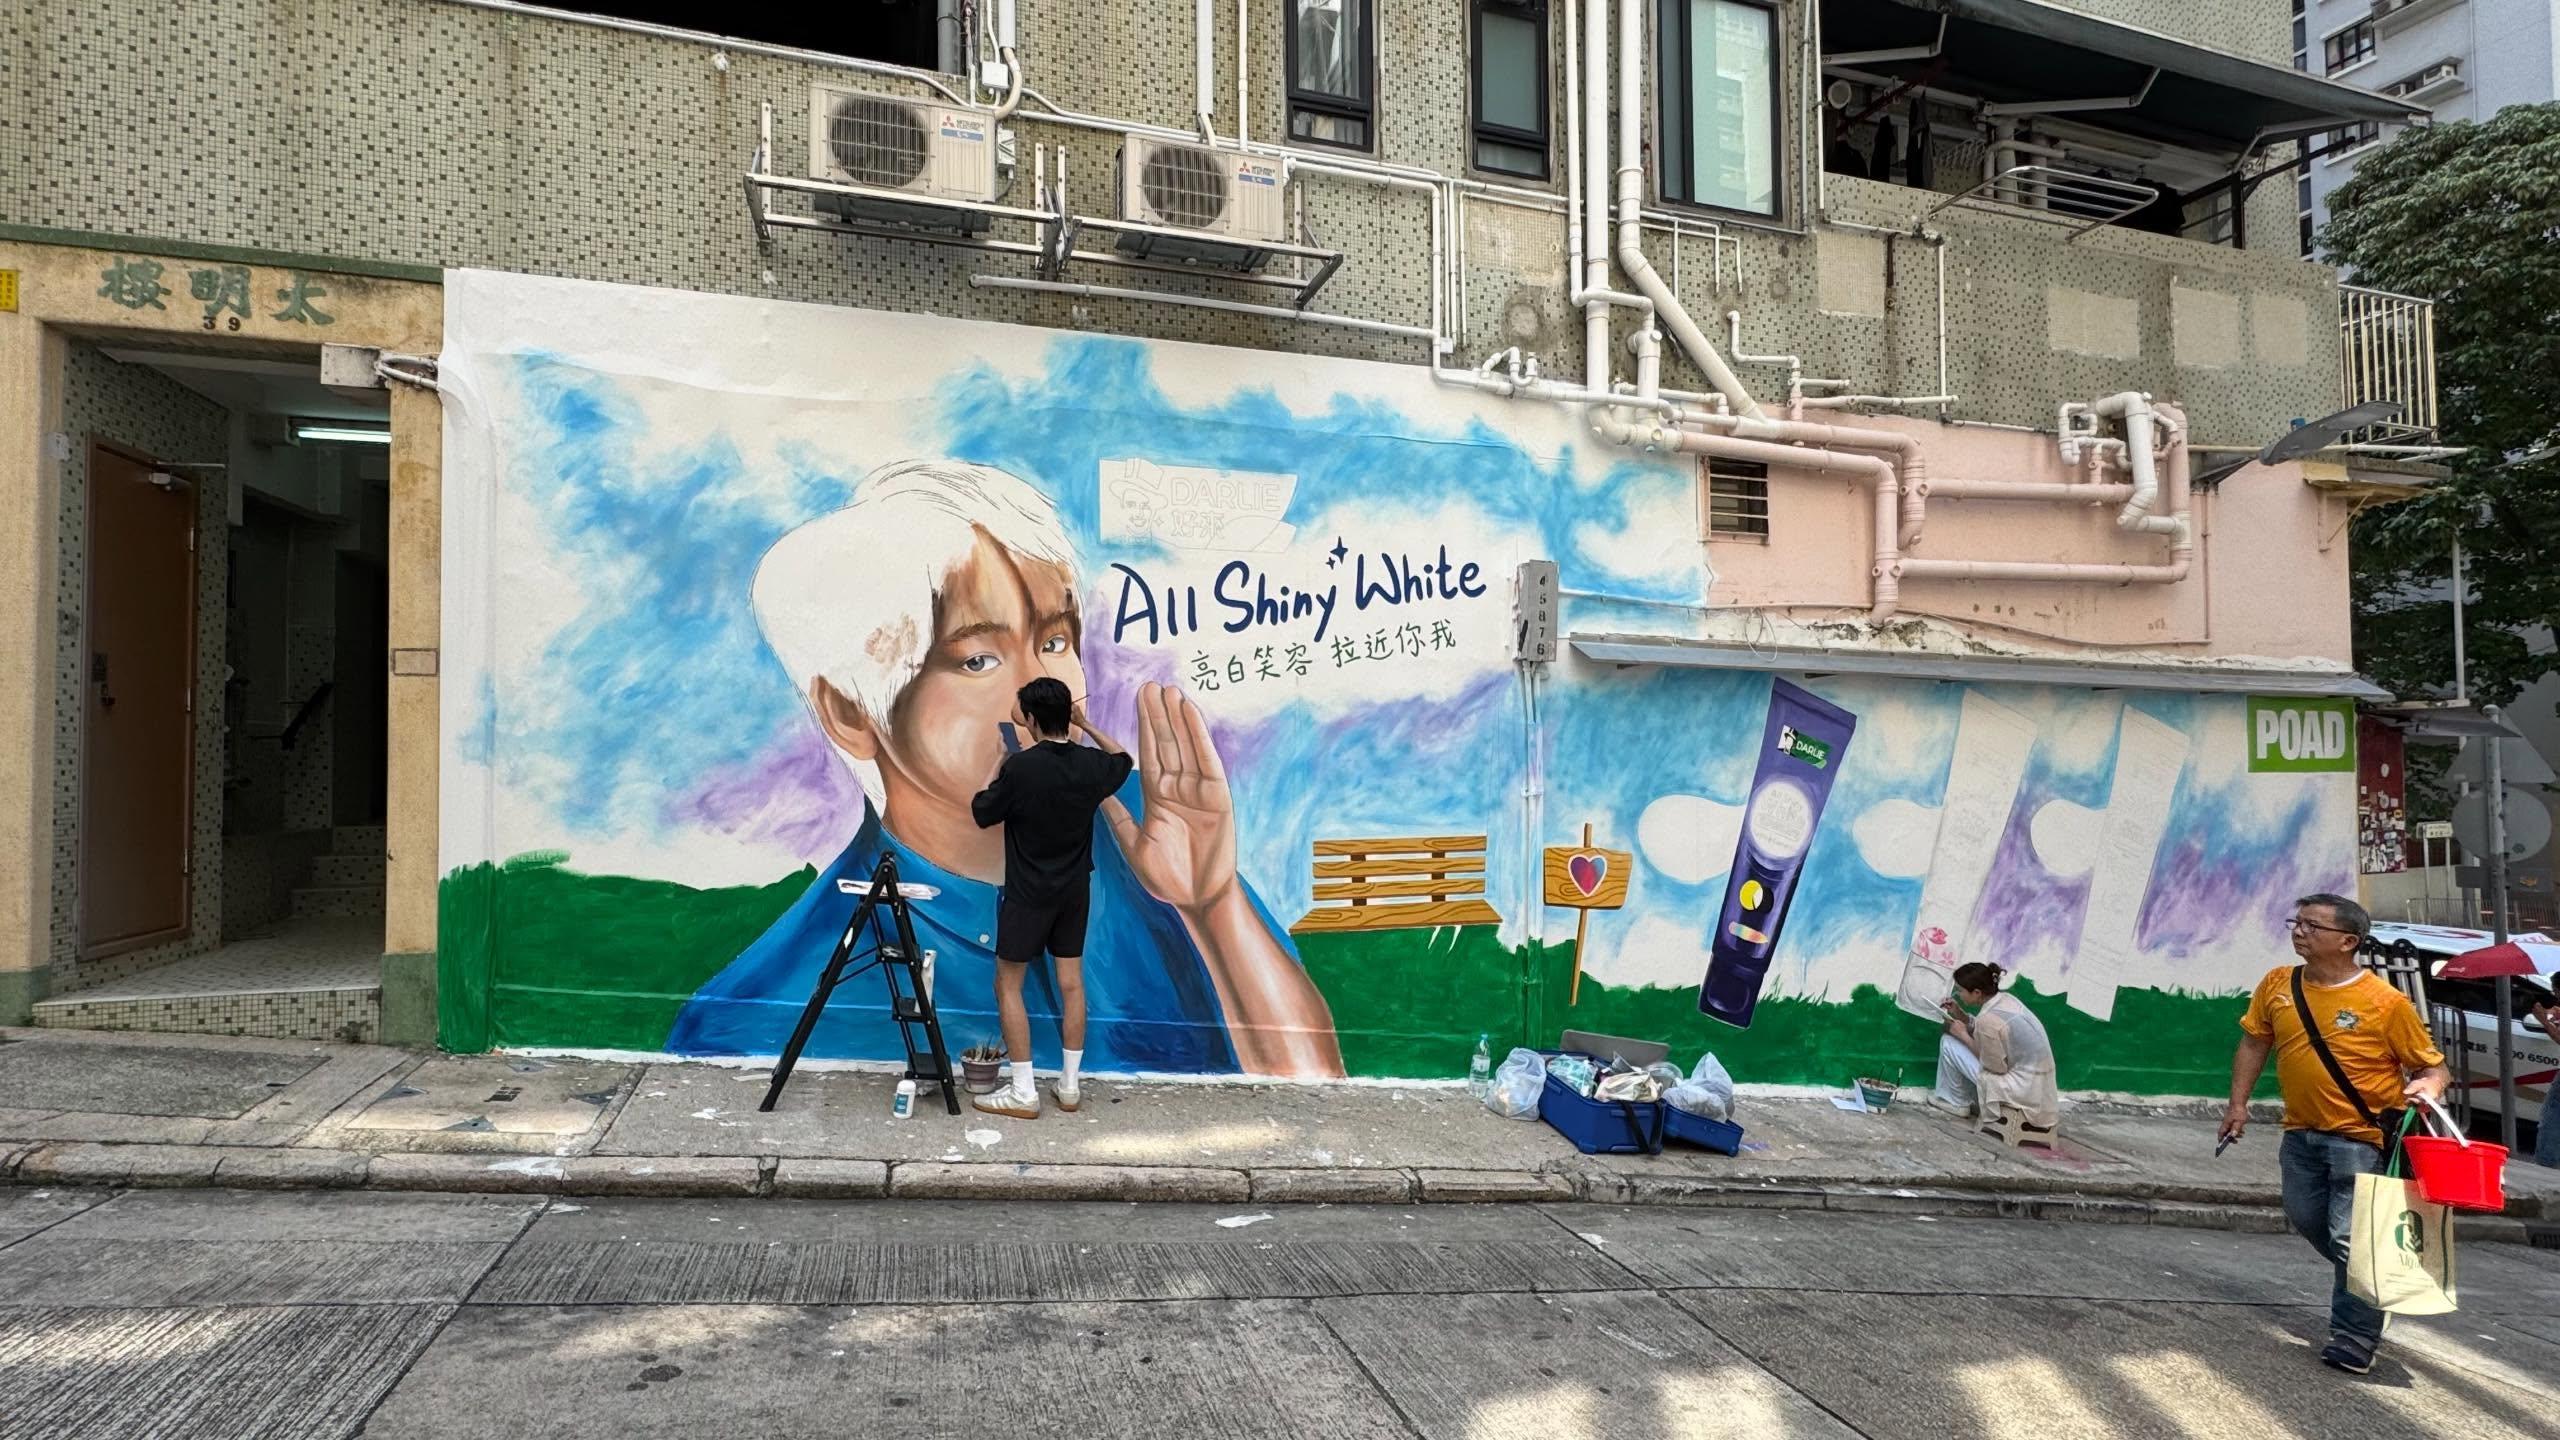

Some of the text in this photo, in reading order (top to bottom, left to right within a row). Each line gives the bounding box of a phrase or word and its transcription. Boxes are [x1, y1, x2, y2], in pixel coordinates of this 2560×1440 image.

[203, 315, 241, 331] 39
[1170, 477, 1281, 512] DARLIE
[1111, 544, 1487, 644] All Shiny White
[1190, 618, 1456, 691] 亮白笑容 拉近你我
[1796, 740, 1825, 760] DARLIE
[2256, 709, 2346, 761] POAD
[2527, 1053, 2559, 1066] 6500
